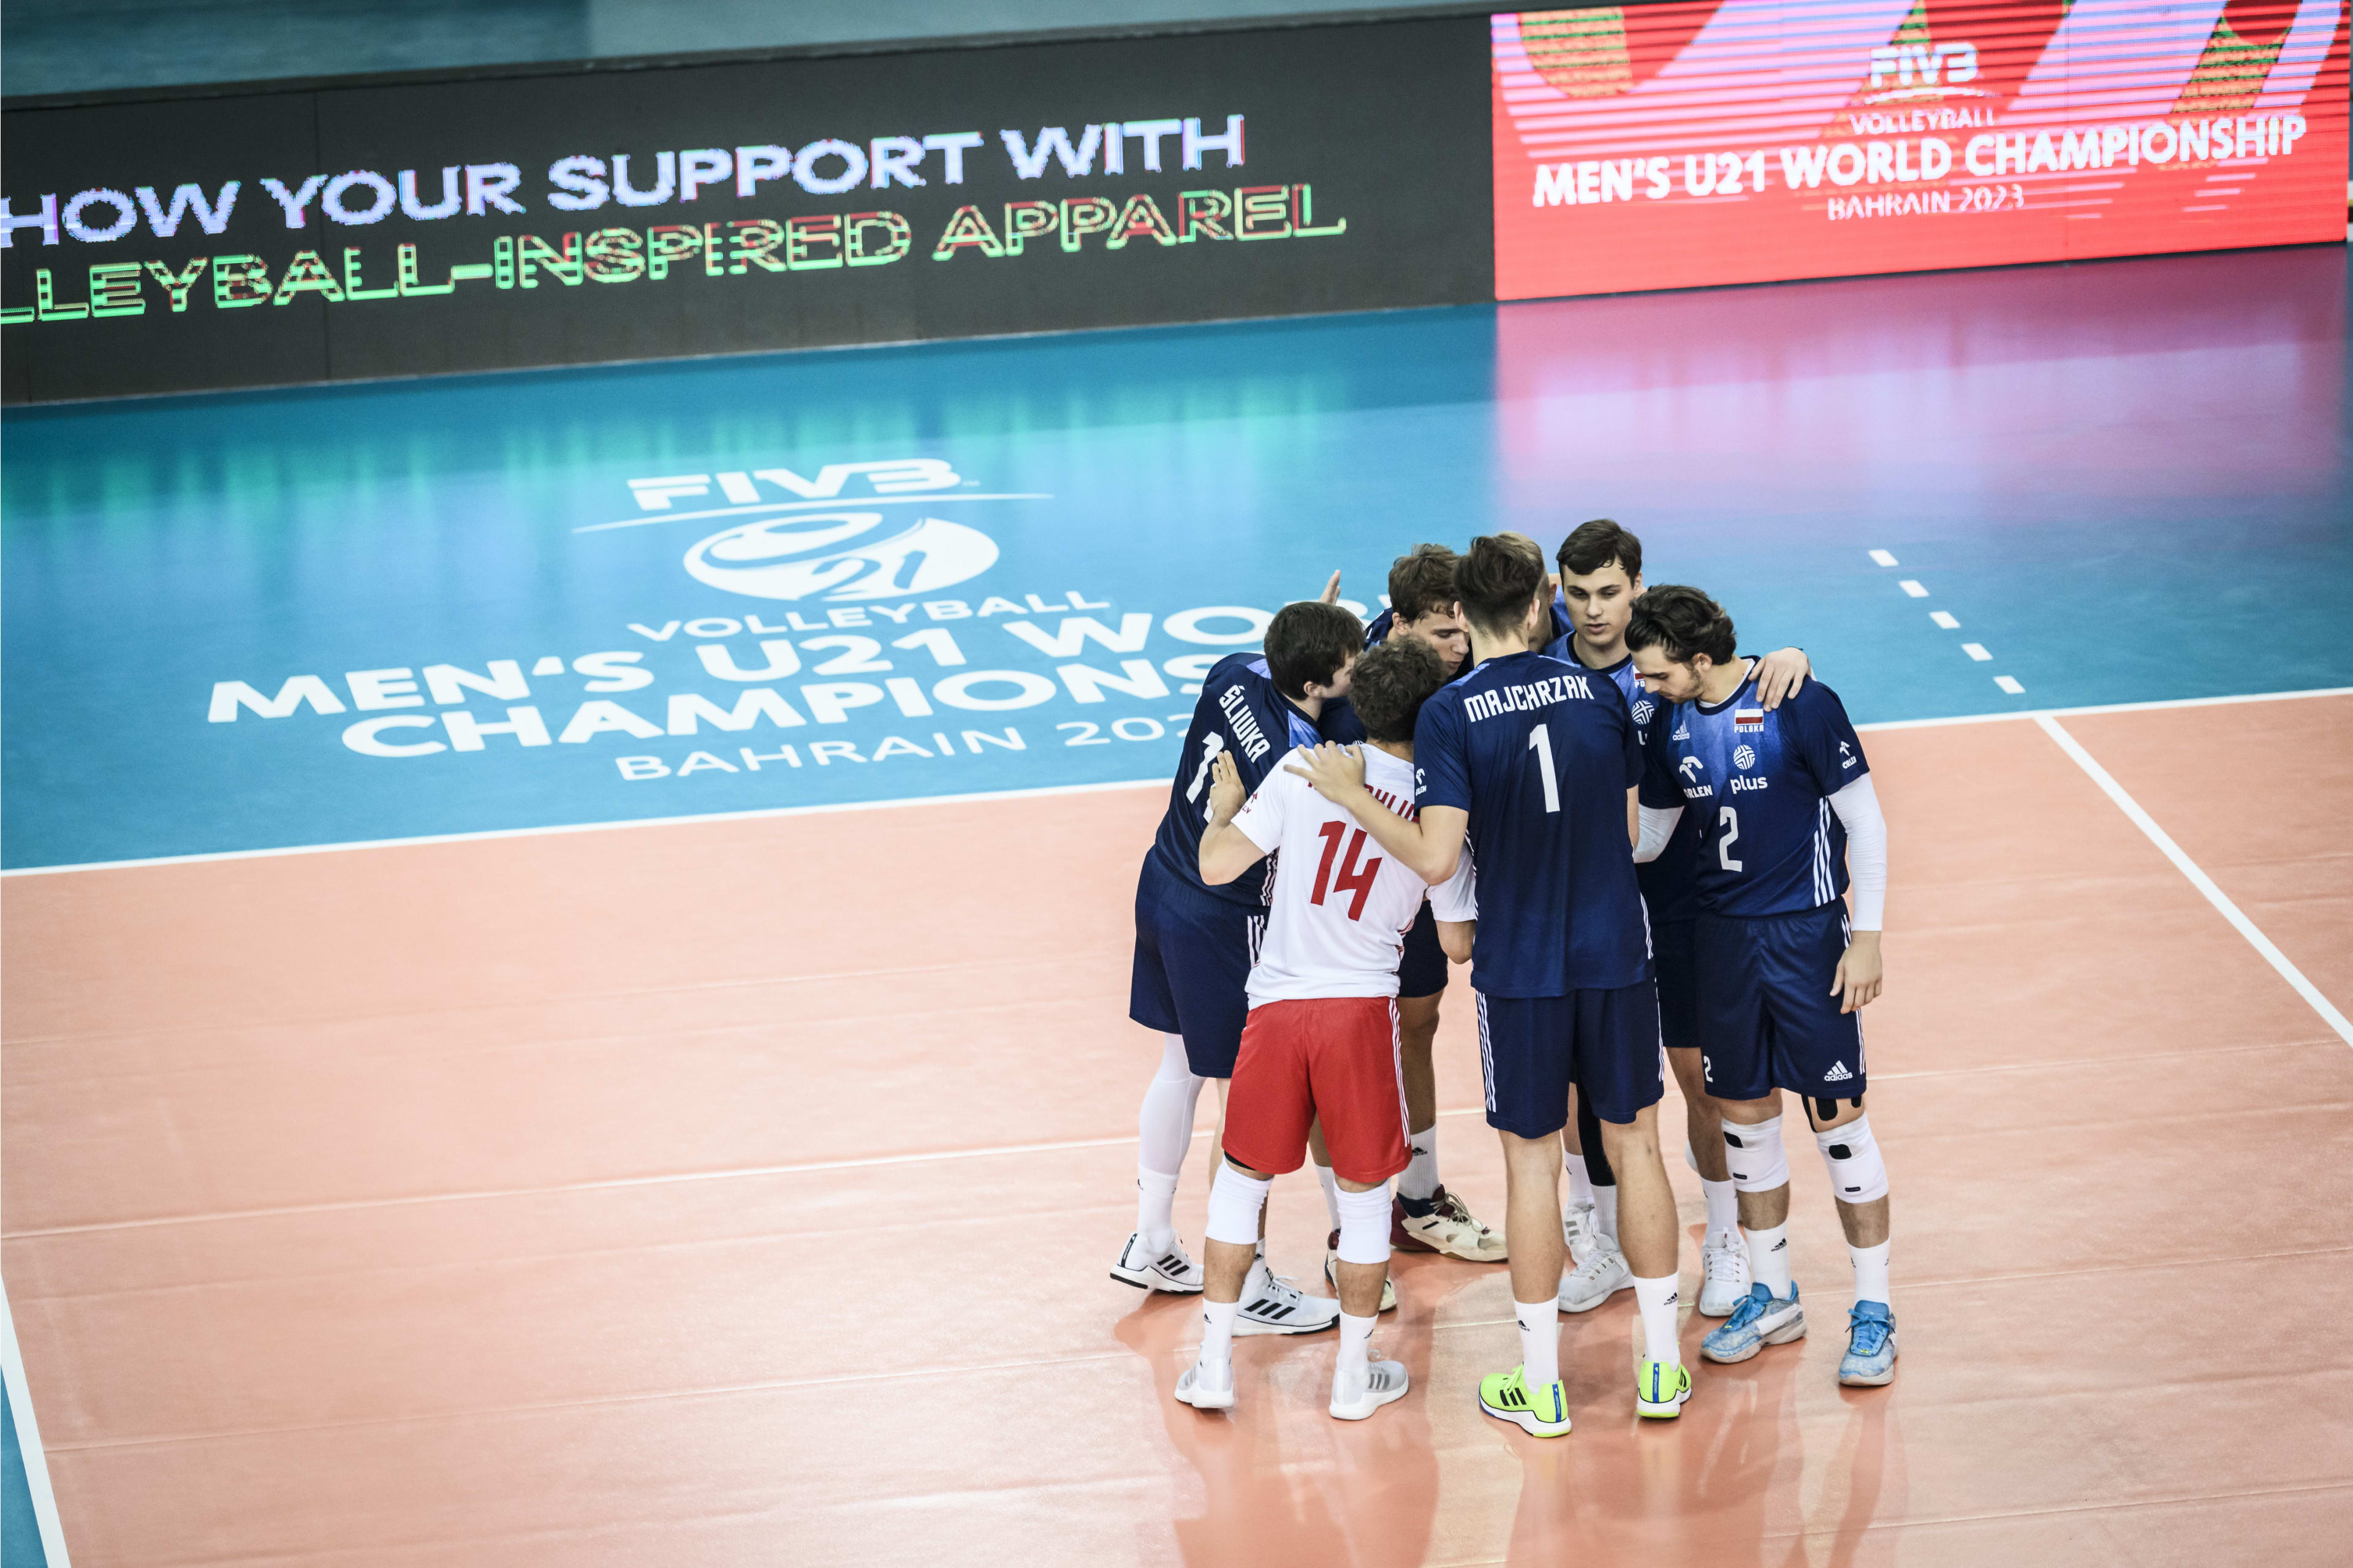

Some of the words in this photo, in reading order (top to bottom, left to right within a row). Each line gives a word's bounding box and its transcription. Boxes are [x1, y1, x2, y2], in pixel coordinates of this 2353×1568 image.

[1870, 41, 1978, 87] FIVB
[1849, 107, 1995, 135] VOLLEYBALL
[260, 162, 526, 229] YOUR
[548, 132, 984, 211] SUPPORT
[999, 114, 1245, 180] WITH
[1532, 156, 1671, 208] MEN'S
[1684, 150, 1765, 197] U21
[1779, 136, 1952, 190] WORLD
[1965, 115, 2307, 177] CHAMPIONSHIP
[932, 183, 1347, 262] APPAREL
[1827, 190, 1950, 221] BAHRAIN
[1958, 183, 2024, 212] 2023
[627, 458, 961, 511] FIVB
[627, 591, 1110, 642] VOLLEYBALL
[208, 651, 654, 723] MEN'S
[695, 627, 967, 683] U21
[1463, 675, 1594, 724] MAJCHRZAK
[615, 725, 1027, 781] BAHRAIN
[1733, 724, 1764, 733] POLSKA
[1528, 723, 1560, 813] 1
[1730, 775, 1768, 795] plus
[1719, 806, 1743, 873] 2
[1310, 820, 1382, 924] 14
[1703, 1055, 1713, 1083] 2
[1824, 1072, 1854, 1081] adidas
